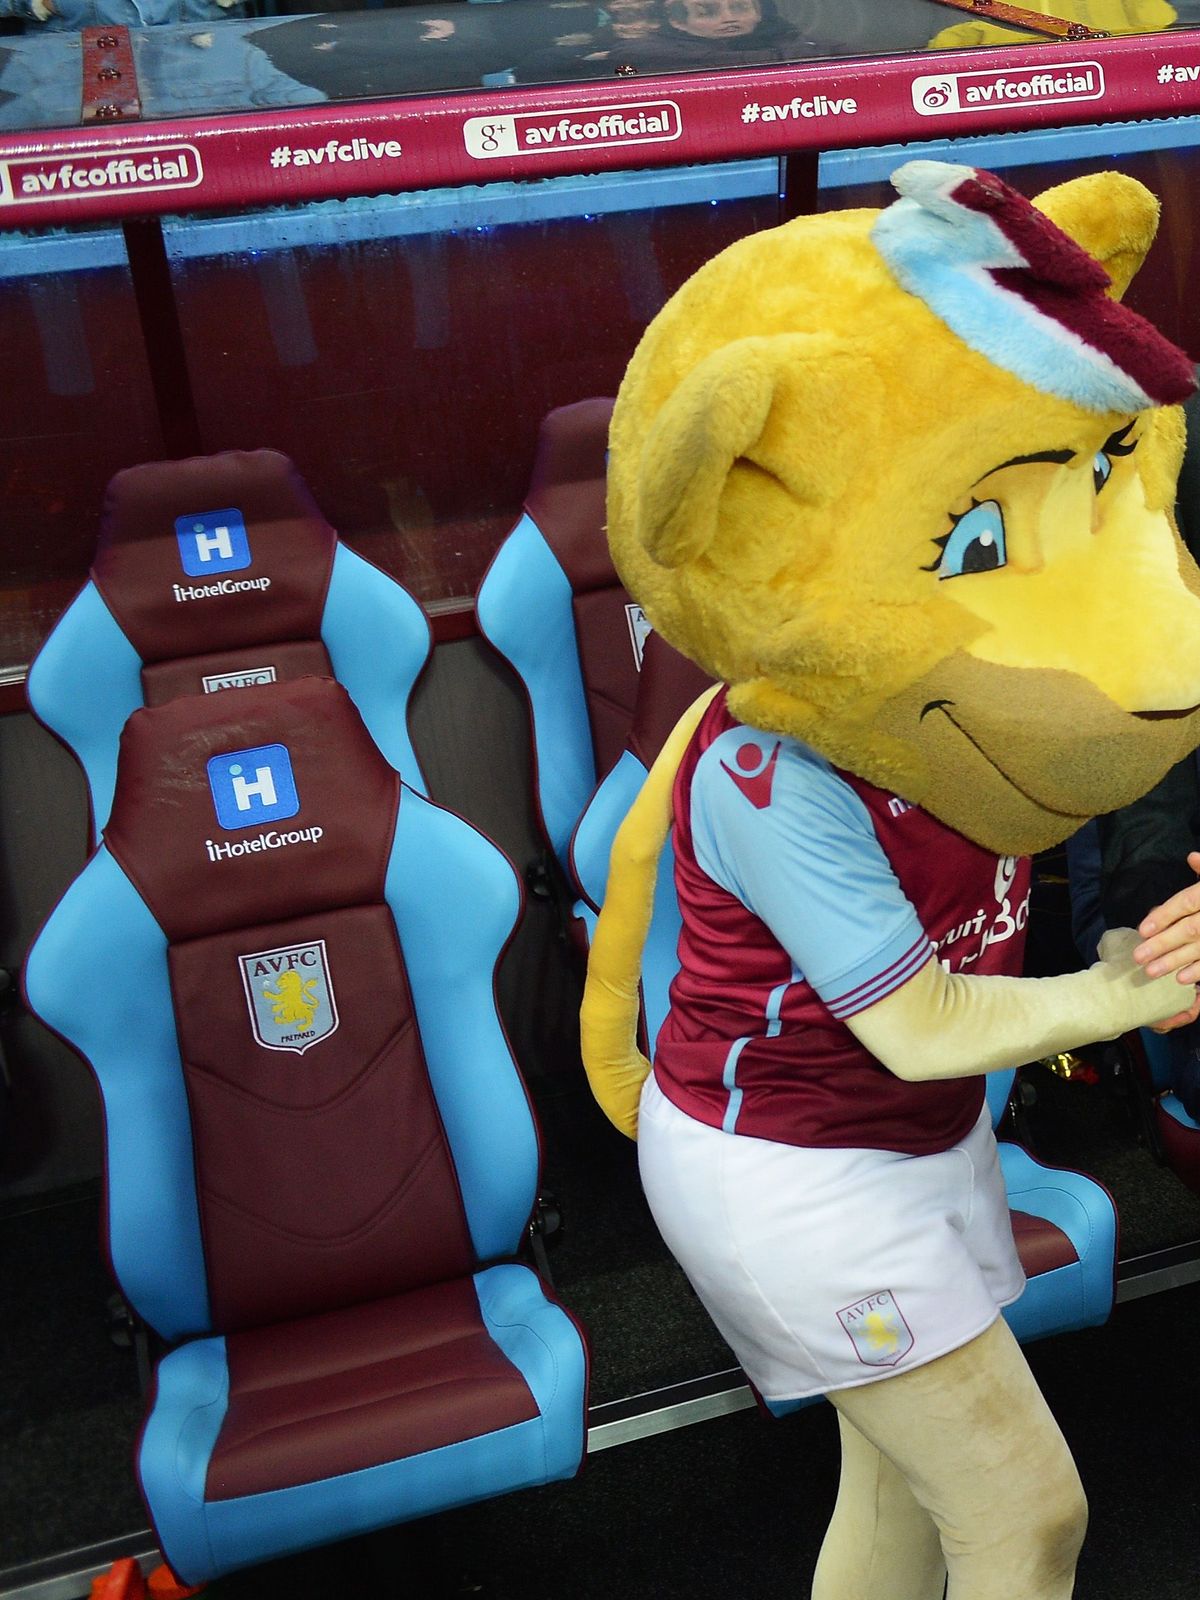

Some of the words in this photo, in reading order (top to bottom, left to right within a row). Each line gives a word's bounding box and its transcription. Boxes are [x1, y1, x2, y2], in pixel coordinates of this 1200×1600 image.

[965, 70, 1094, 103] avfcofficial
[741, 95, 858, 124] #avfclive
[524, 110, 670, 145] avfcofficial
[270, 138, 402, 169] #avfclive
[21, 155, 189, 193] avfcofficial
[172, 577, 271, 602] iHotelGroup
[205, 826, 323, 862] iHotelGroup
[253, 950, 317, 977] AVFC
[846, 1293, 889, 1323] AVFC
